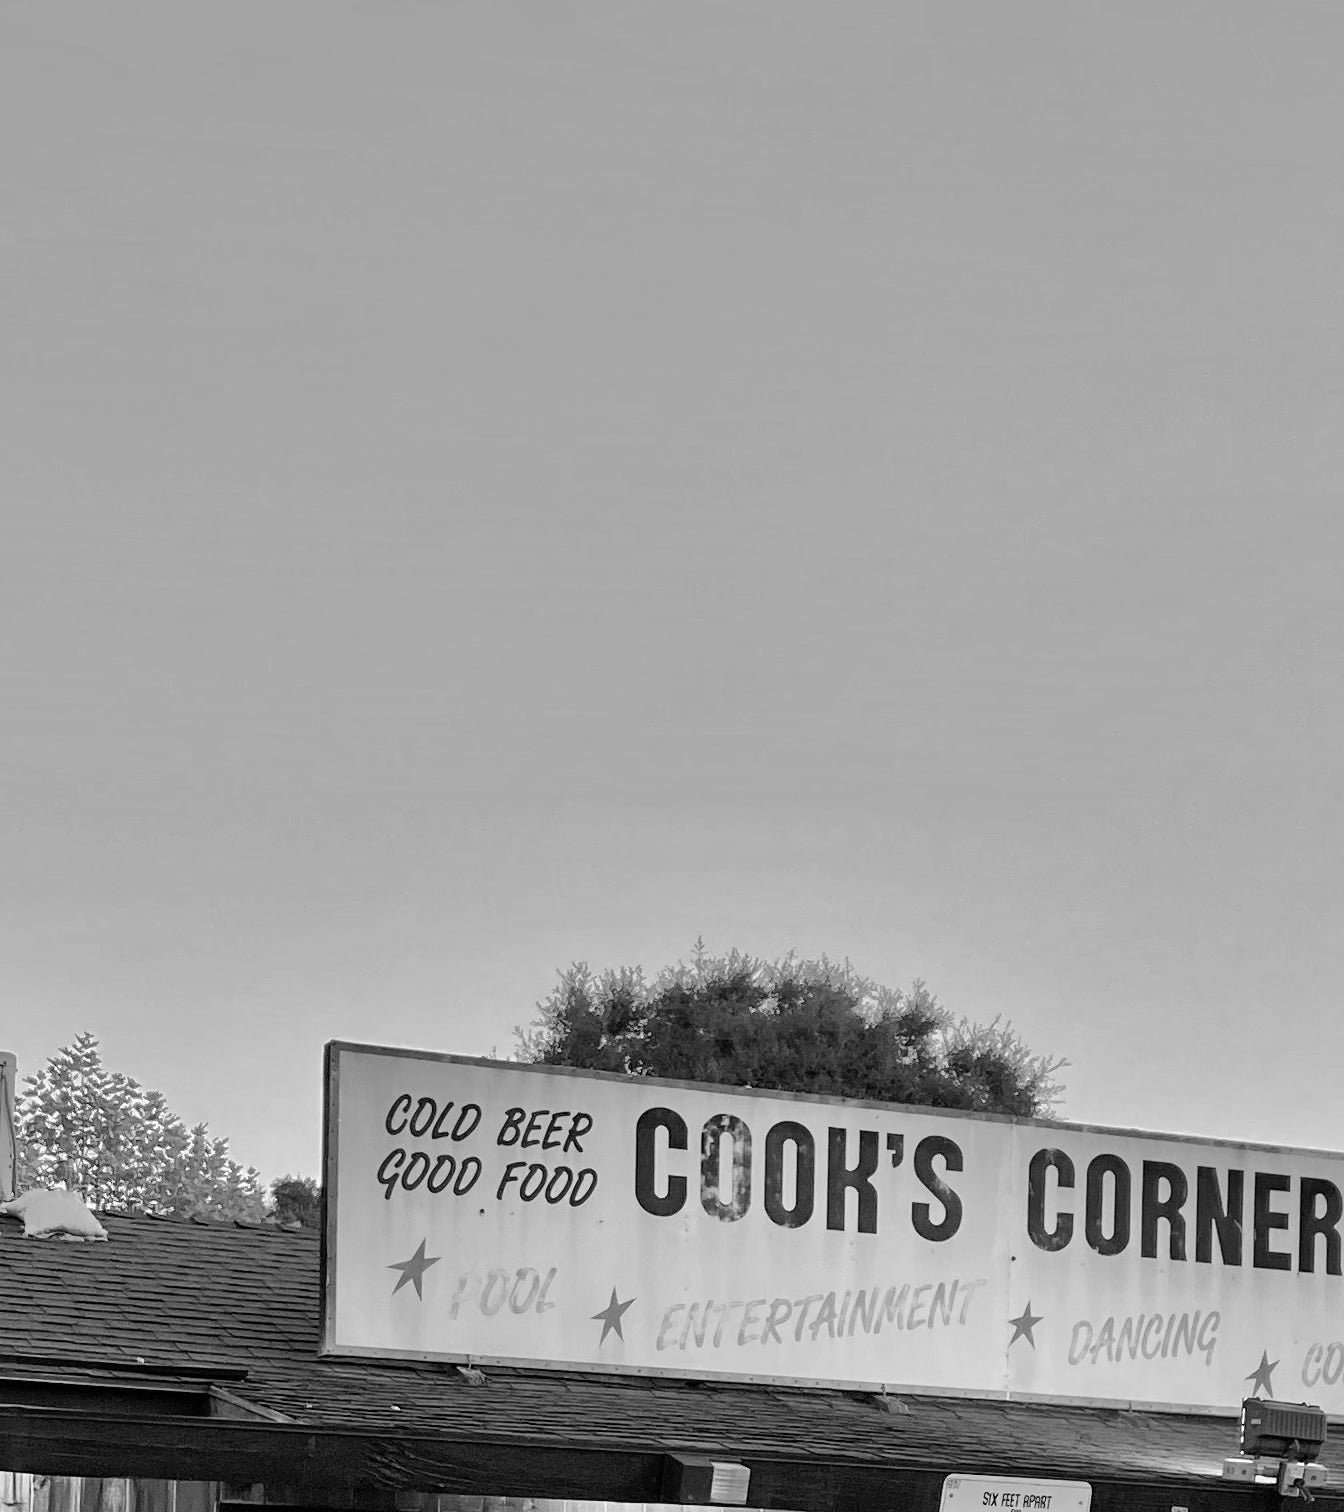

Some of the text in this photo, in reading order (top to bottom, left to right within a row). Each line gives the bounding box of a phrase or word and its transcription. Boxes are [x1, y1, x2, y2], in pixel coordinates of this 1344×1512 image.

[385, 1093, 594, 1154] COLD BEER
[377, 1148, 599, 1207] GOOD FOOD
[635, 1106, 1344, 1276] COOK'S CORNER
[449, 1266, 559, 1320] POOL
[656, 1278, 990, 1351] ENTERTAINMENT
[1067, 1310, 1222, 1367] DANCING
[983, 1491, 1053, 1510] SIX FEET APART
